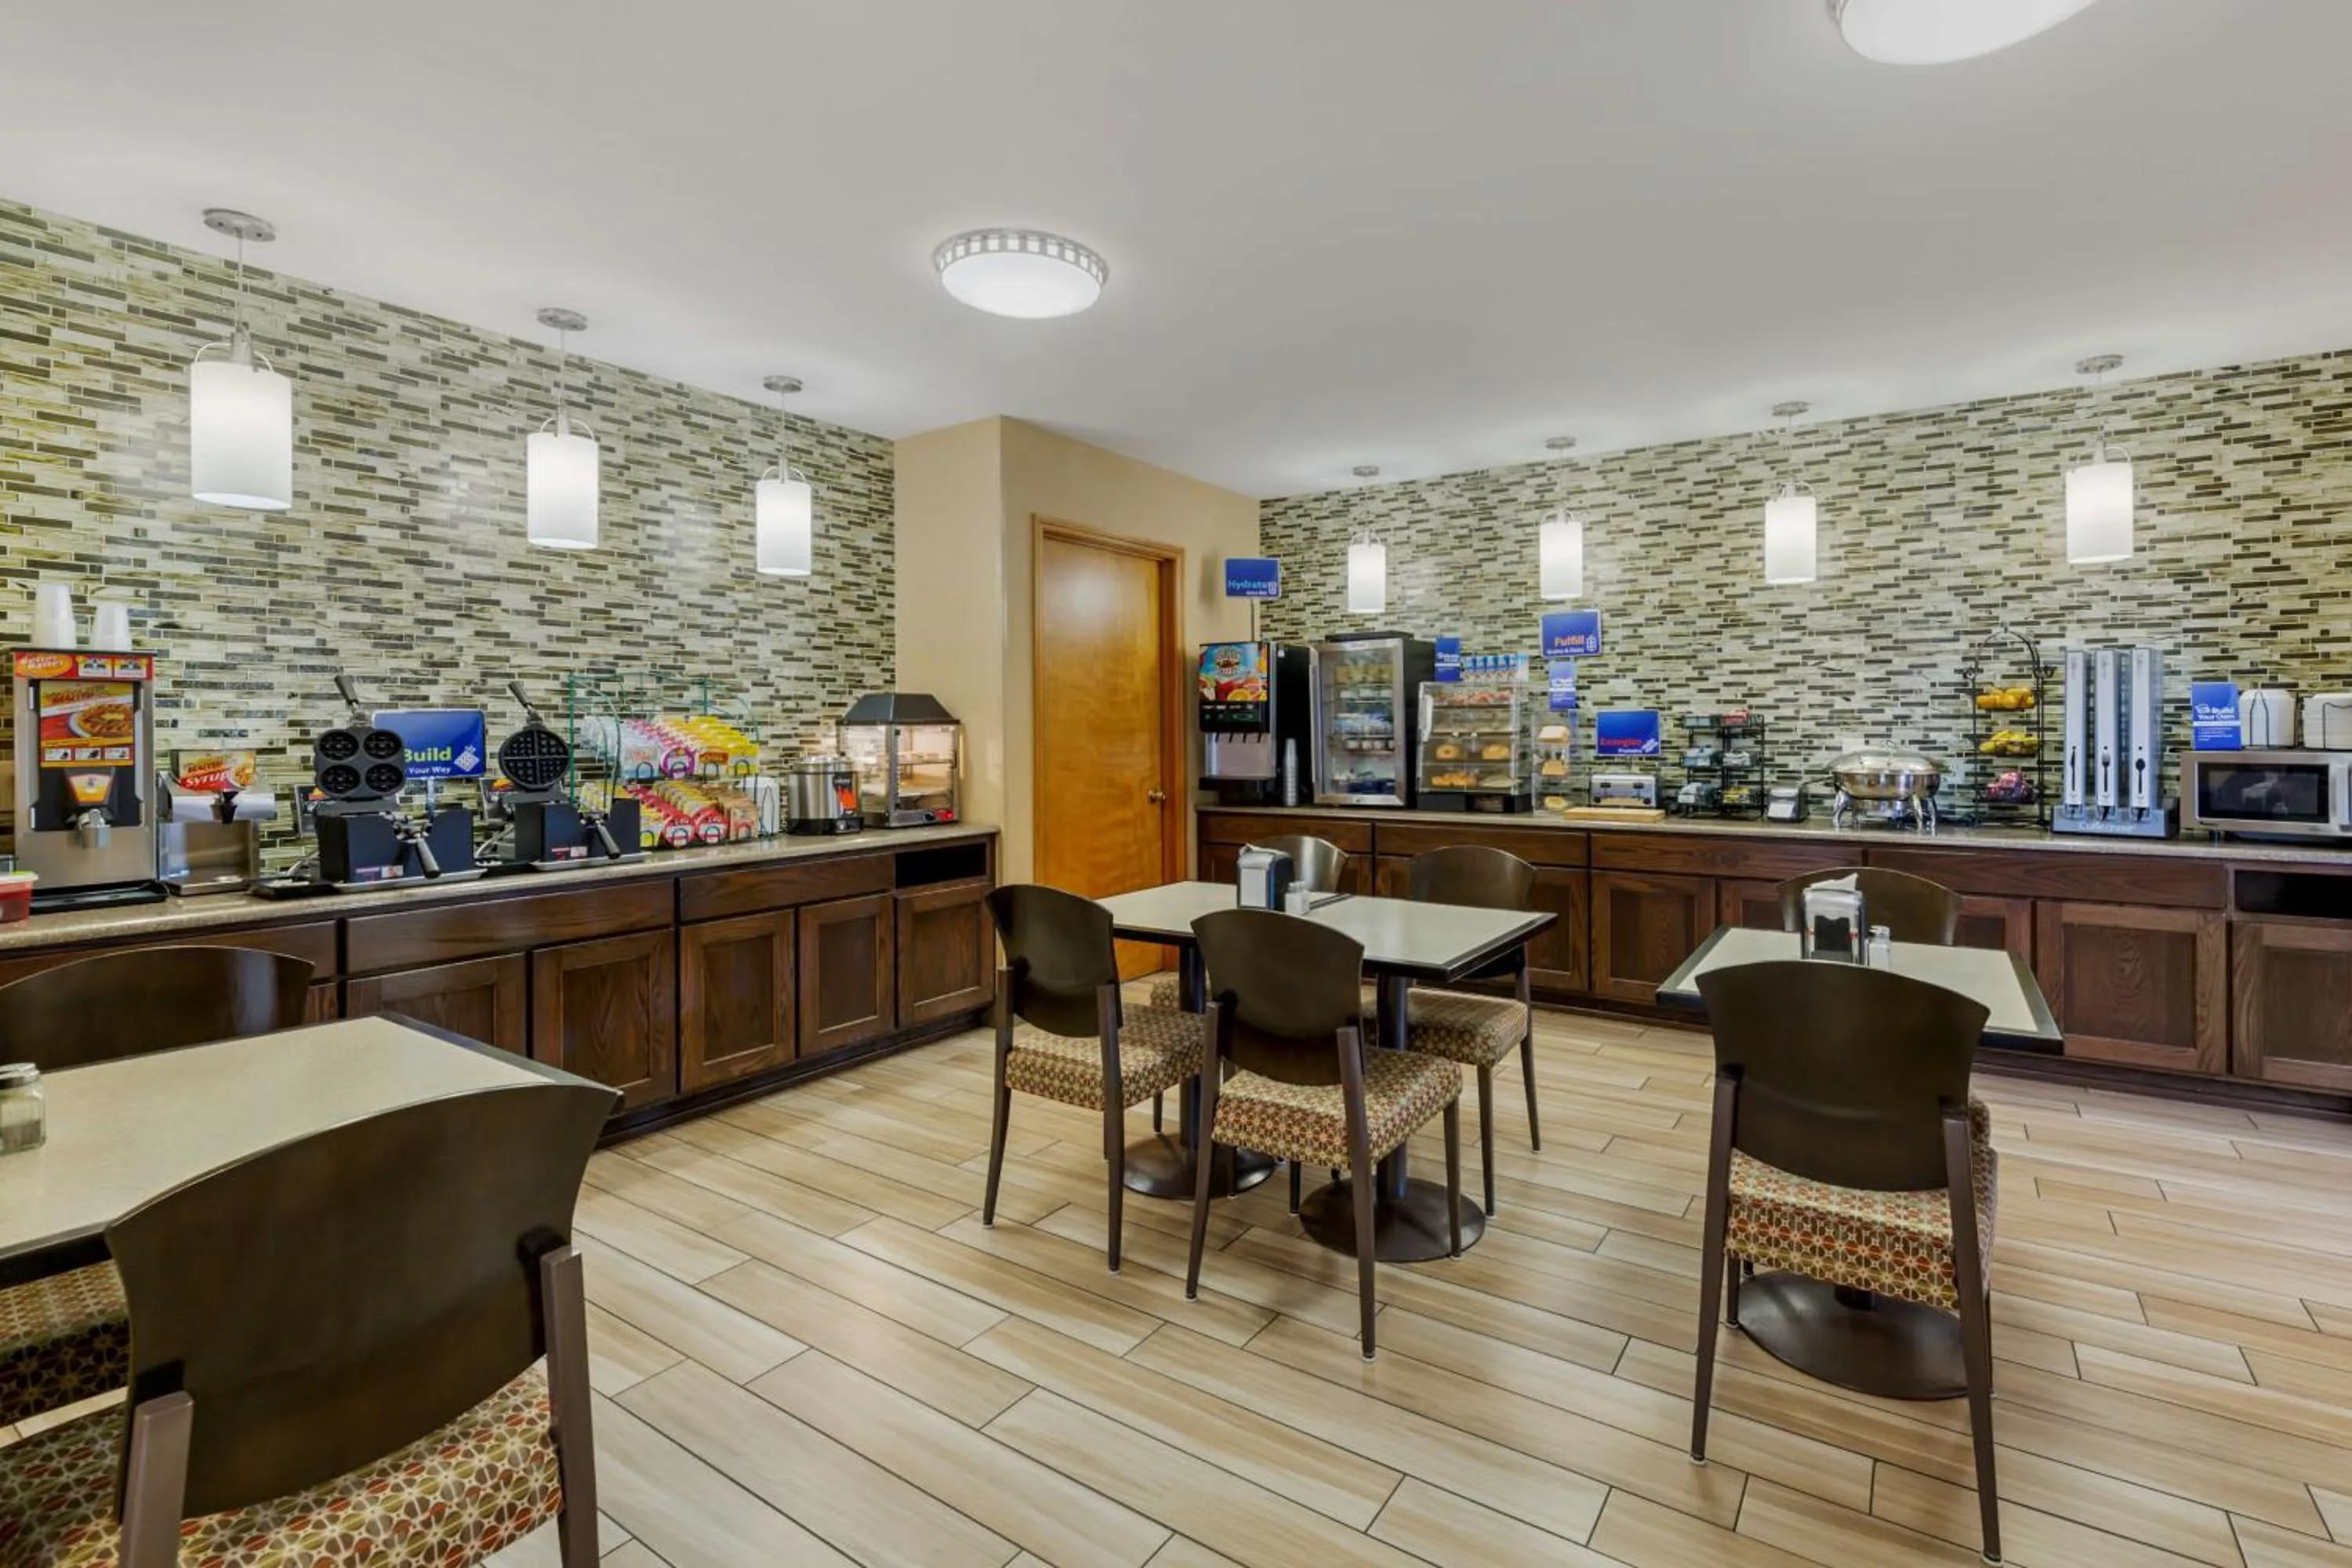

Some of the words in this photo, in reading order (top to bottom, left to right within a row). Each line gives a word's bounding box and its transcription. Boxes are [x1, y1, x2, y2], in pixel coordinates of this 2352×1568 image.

[1555, 634, 1584, 647] Fulfill
[404, 746, 452, 762] Build
[431, 766, 451, 775] Way
